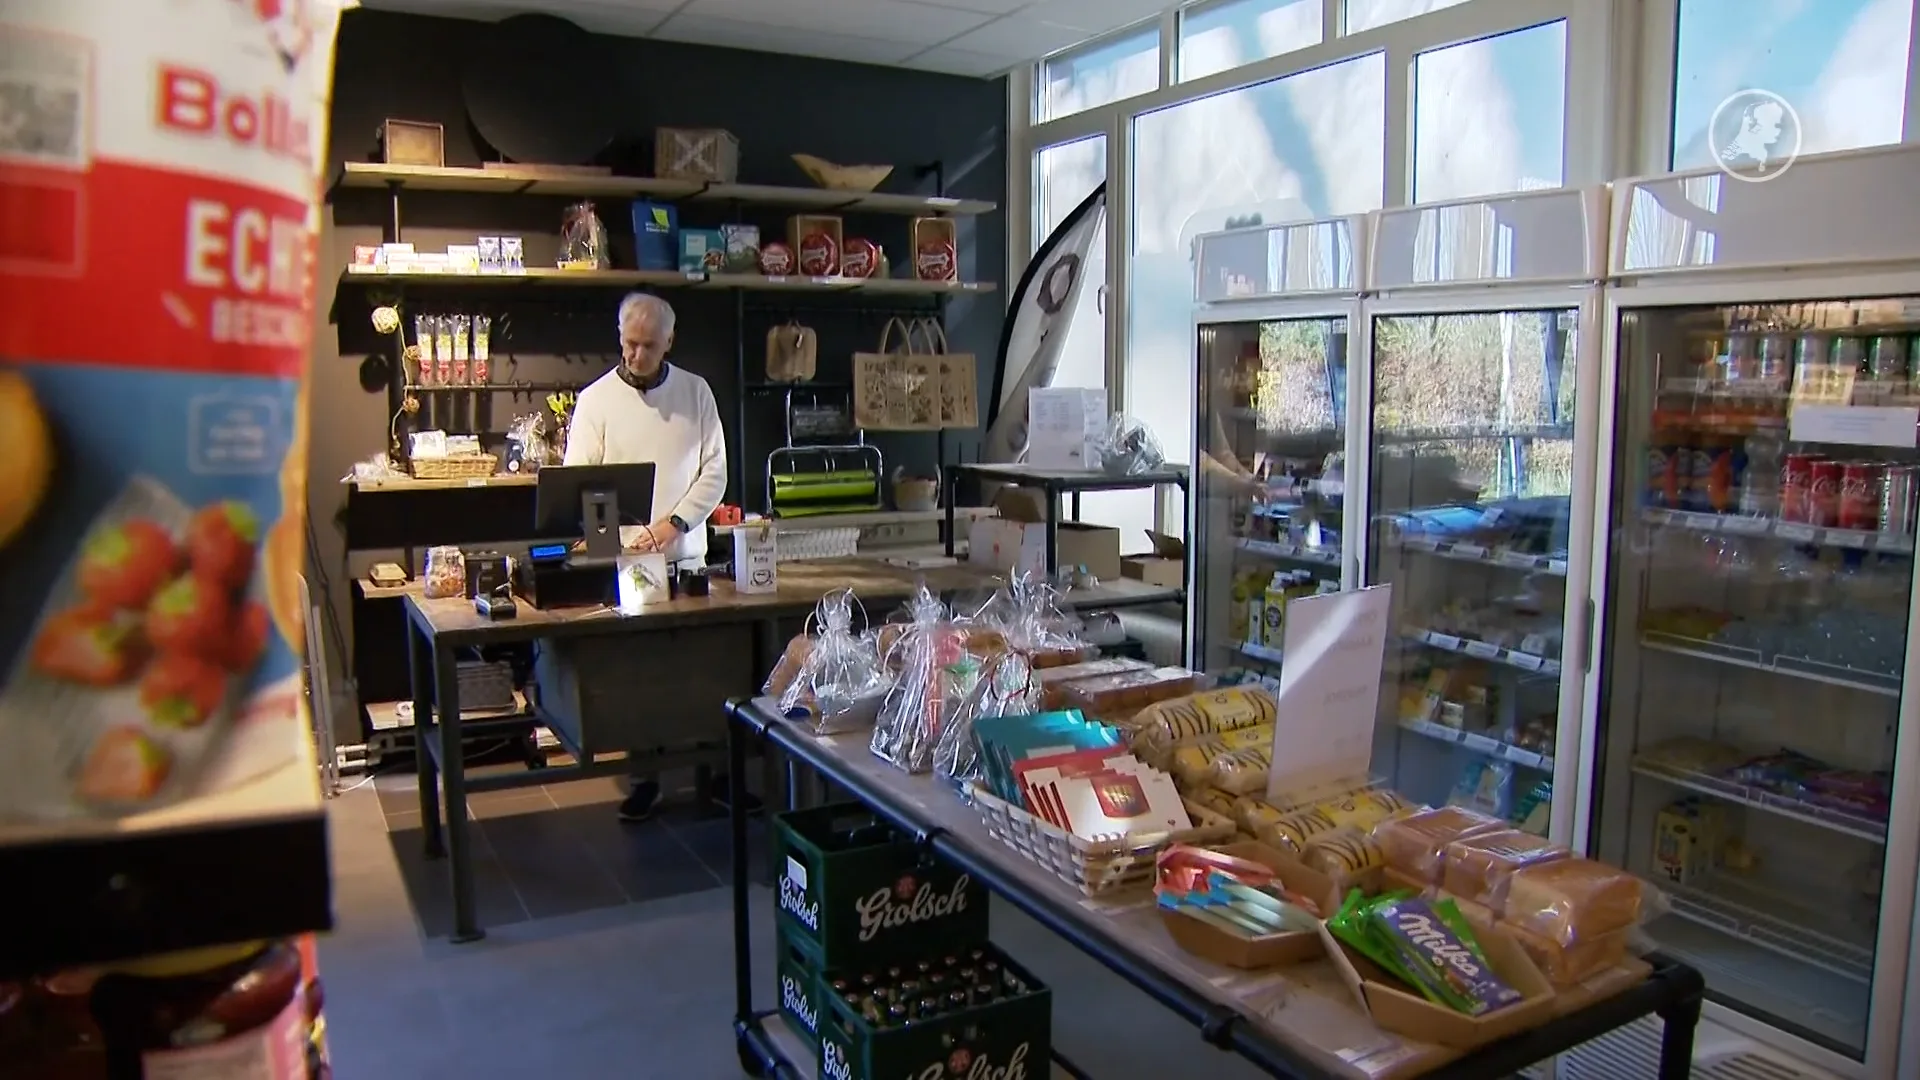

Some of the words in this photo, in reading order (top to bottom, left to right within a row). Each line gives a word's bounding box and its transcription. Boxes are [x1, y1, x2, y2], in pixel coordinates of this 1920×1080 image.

[779, 874, 818, 931] Grolsch
[856, 873, 969, 941] Grolsch
[1398, 912, 1479, 977] Milka
